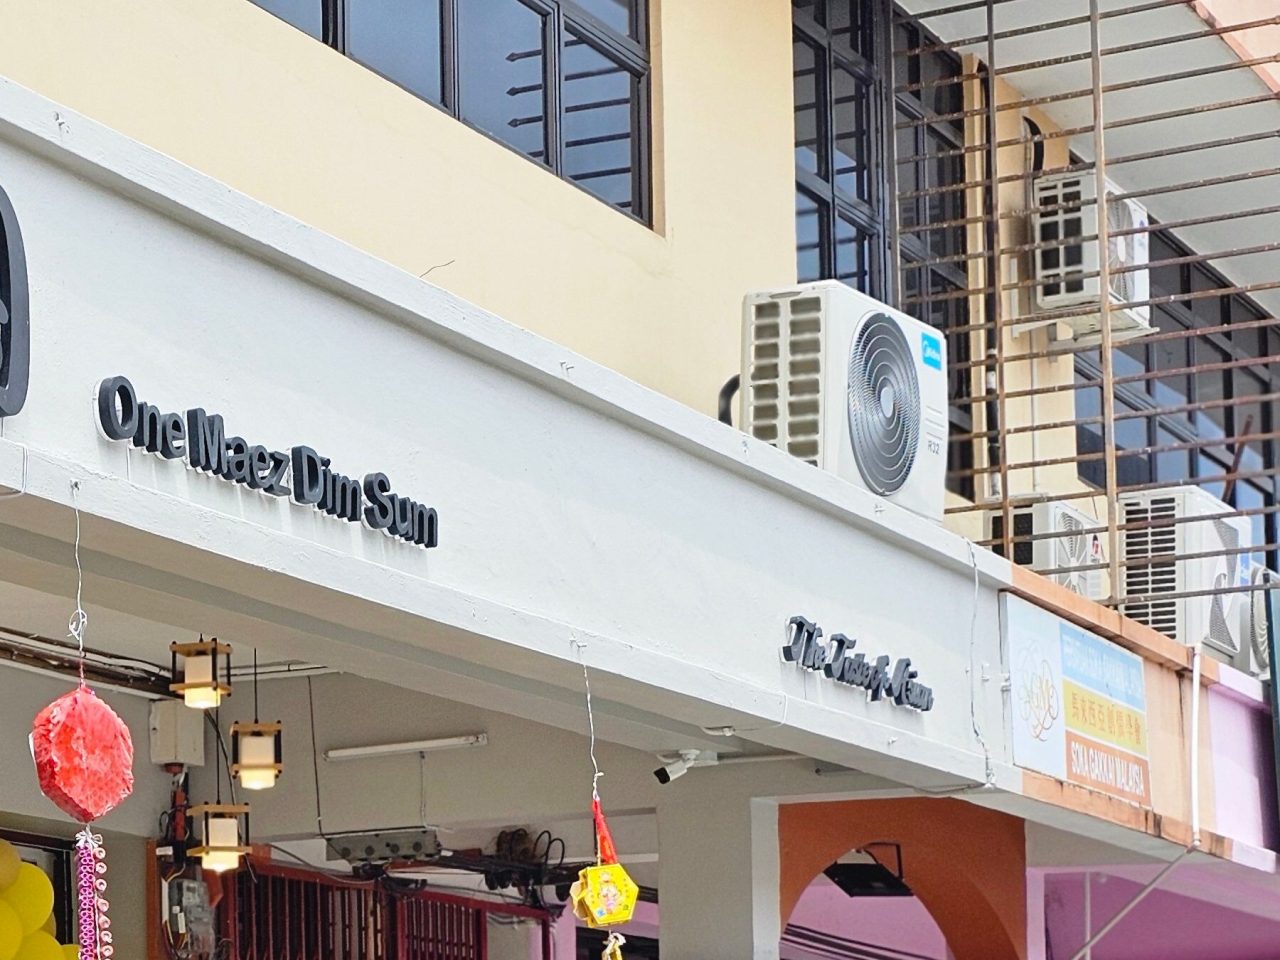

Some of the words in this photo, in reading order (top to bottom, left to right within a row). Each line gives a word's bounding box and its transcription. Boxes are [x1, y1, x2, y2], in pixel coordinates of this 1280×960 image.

[93, 375, 187, 461] One
[185, 407, 291, 497] Maez
[290, 444, 362, 523] Dim
[361, 471, 439, 549] Sum
[779, 615, 826, 672] The
